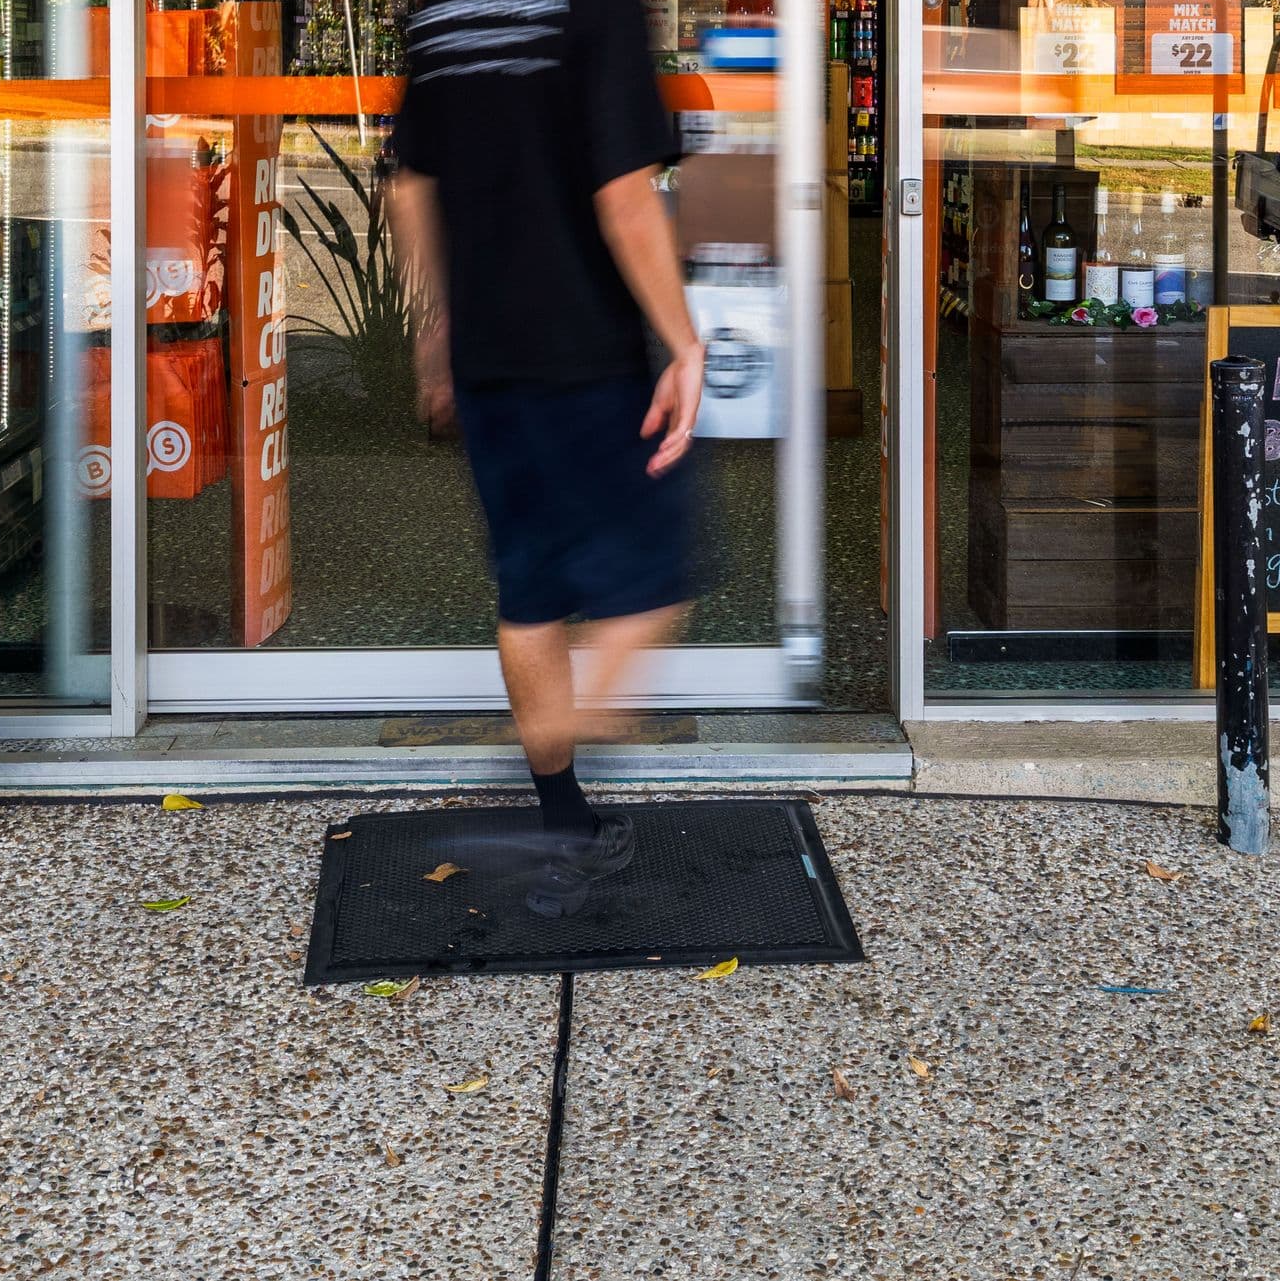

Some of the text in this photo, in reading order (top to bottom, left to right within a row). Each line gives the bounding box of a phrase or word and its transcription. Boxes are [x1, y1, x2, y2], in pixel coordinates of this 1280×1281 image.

[1174, 4, 1200, 16] MIX
[1169, 19, 1216, 31] MATCH
[1172, 43, 1212, 67] $22
